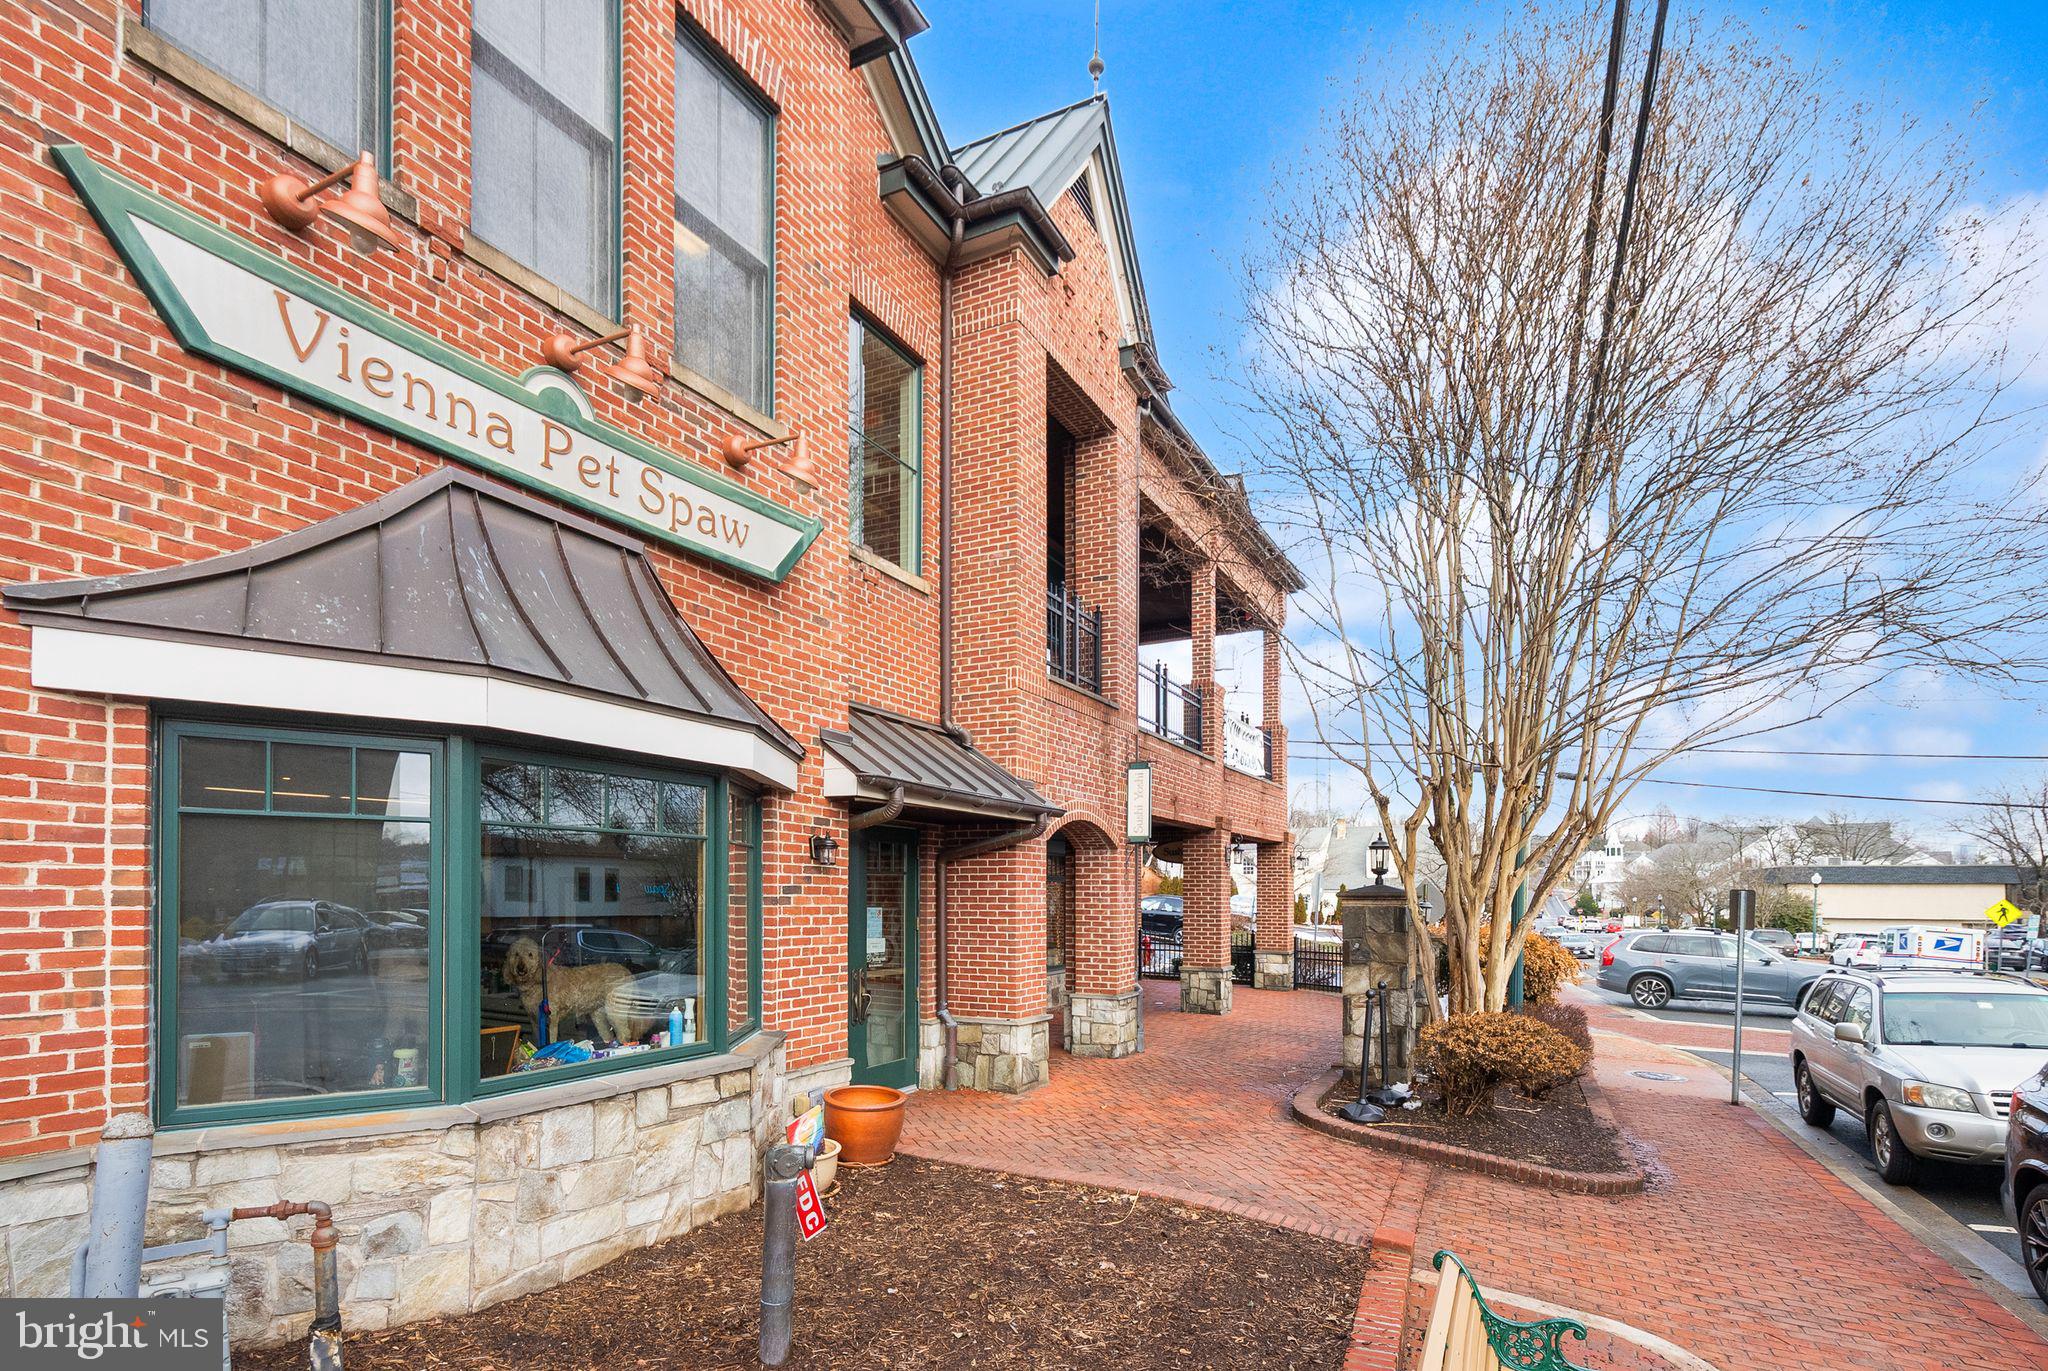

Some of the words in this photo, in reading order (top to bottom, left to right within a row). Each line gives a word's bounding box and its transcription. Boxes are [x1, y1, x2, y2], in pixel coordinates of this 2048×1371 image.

[274, 290, 515, 454] Vienna
[541, 417, 620, 497] Pet
[639, 466, 750, 548] Spaw
[1133, 804, 1144, 834] Sushi
[797, 1174, 819, 1231] FDC
